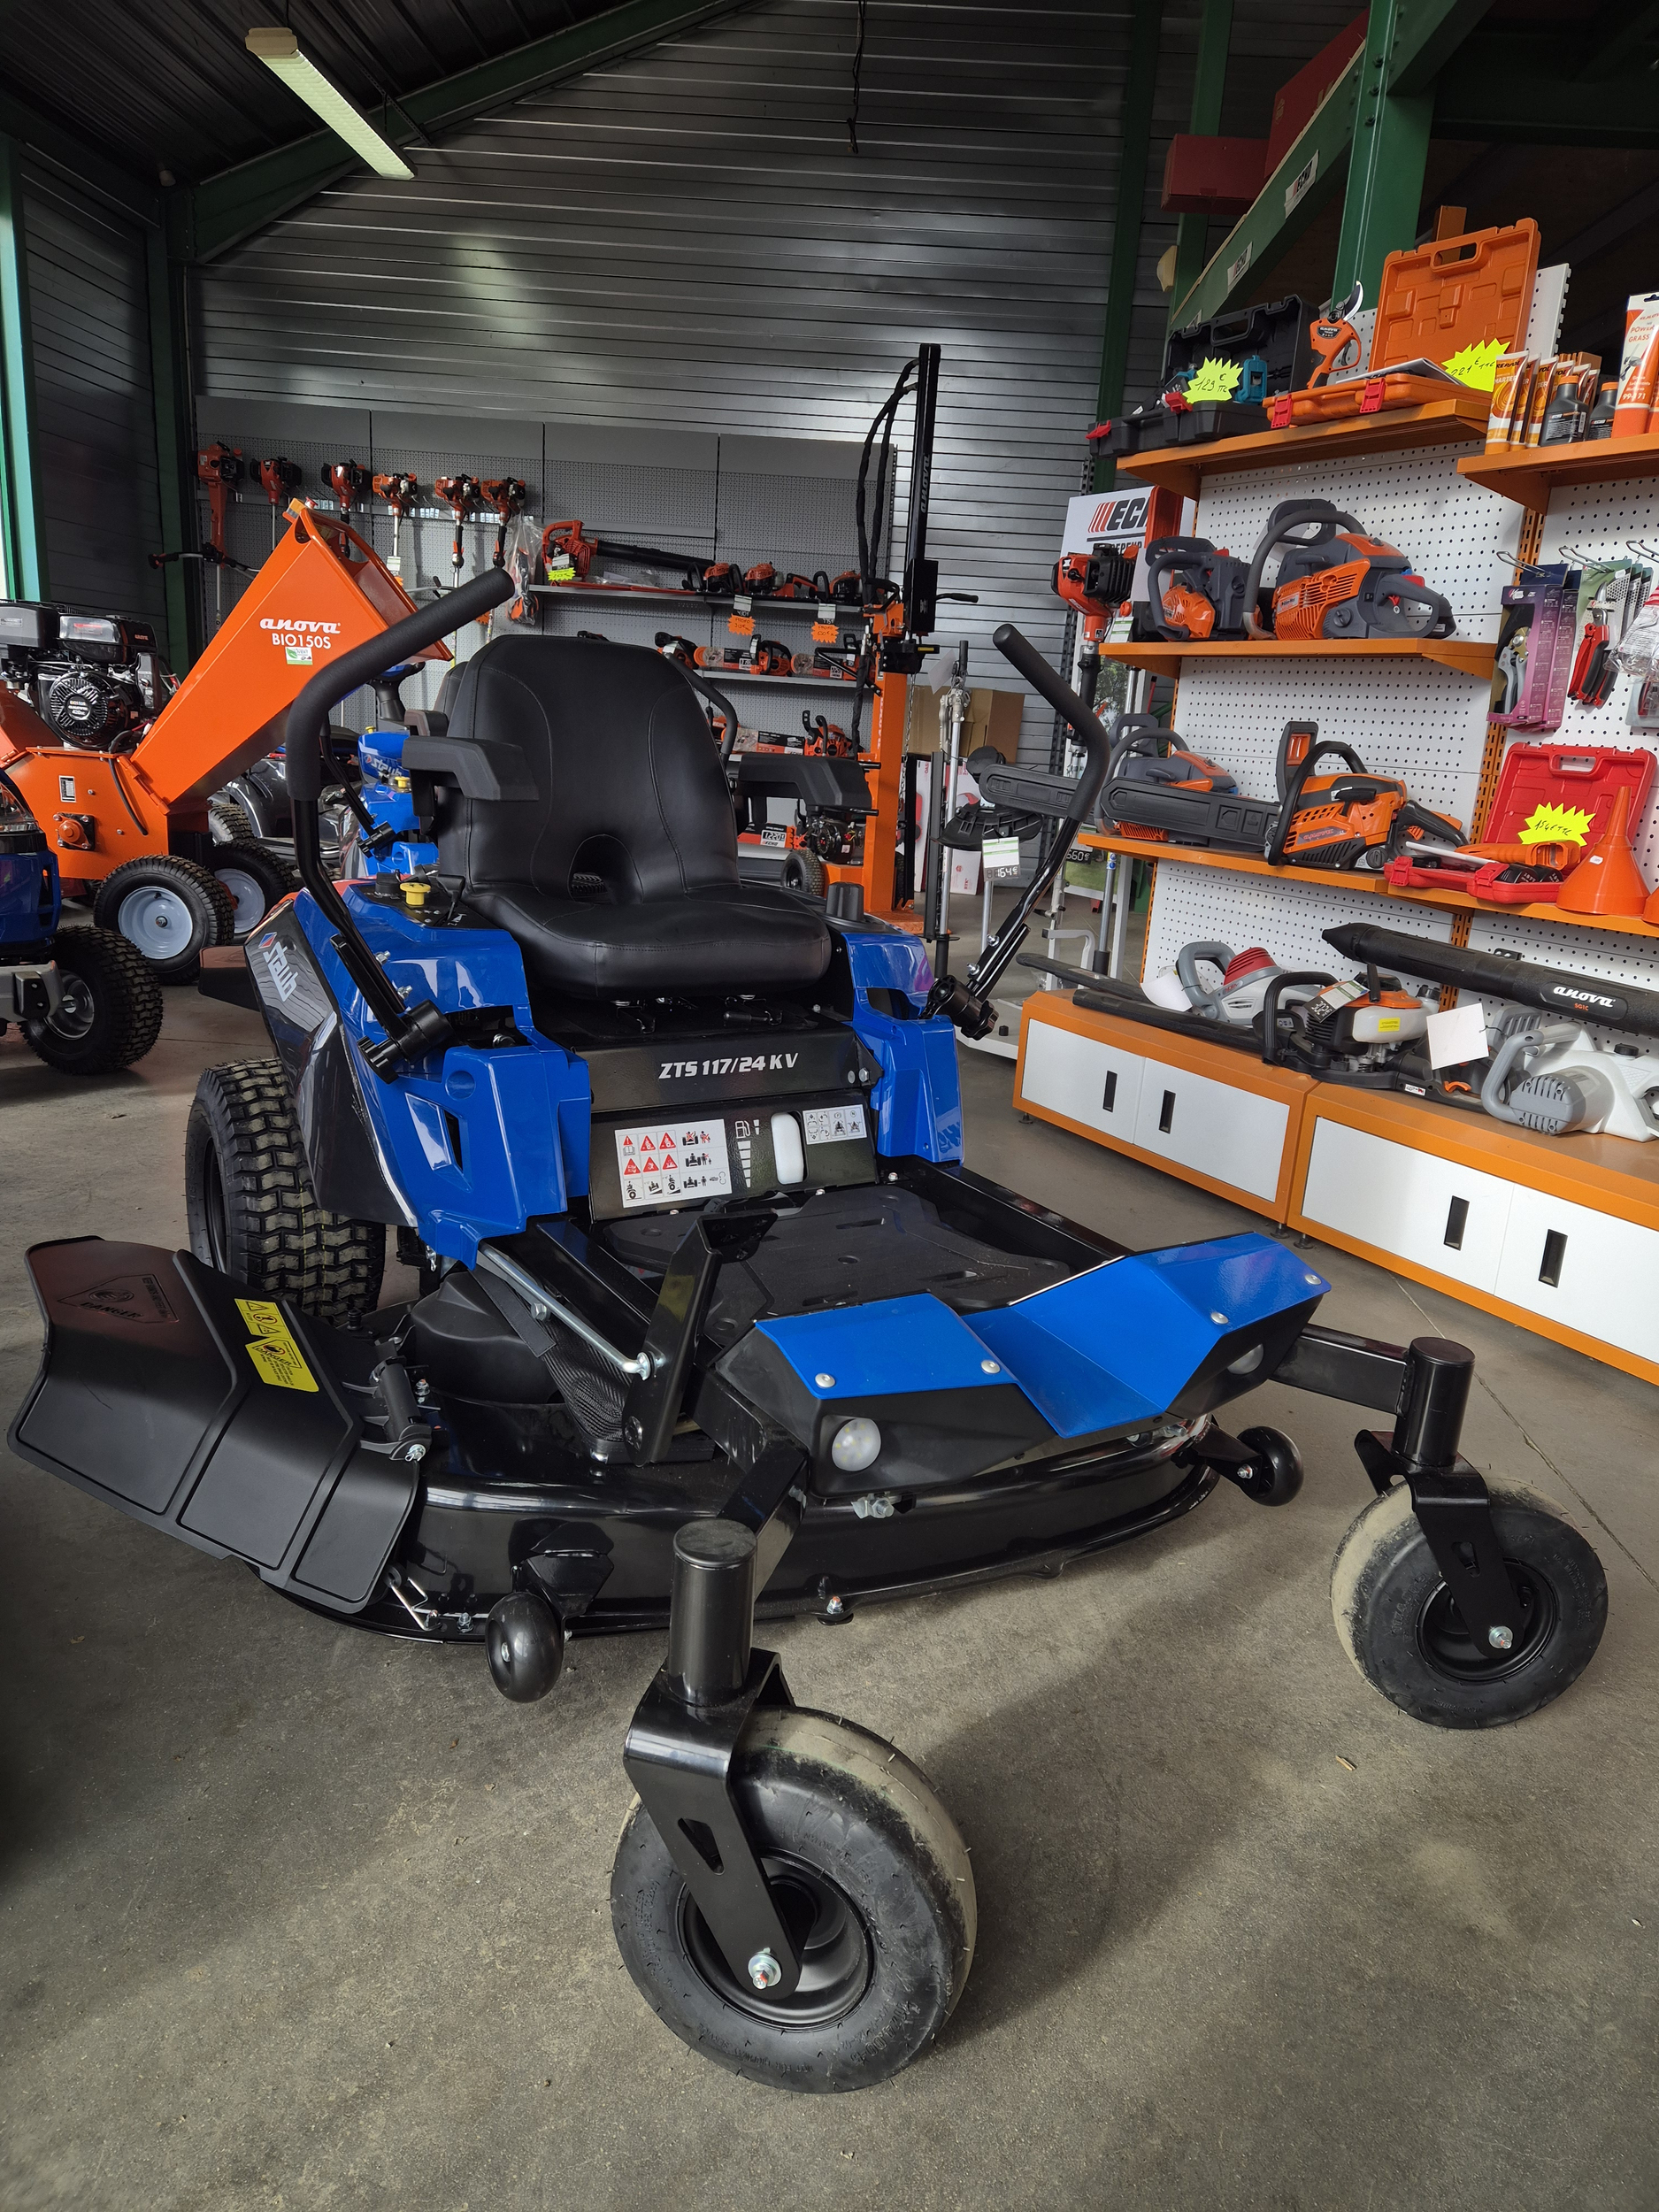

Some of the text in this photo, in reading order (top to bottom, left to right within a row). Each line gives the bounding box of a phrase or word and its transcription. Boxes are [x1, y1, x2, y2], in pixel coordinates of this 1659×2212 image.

[1628, 334, 1650, 342] GRASS
[272, 633, 332, 649] BIO150S
[263, 941, 299, 1002] staub
[658, 1061, 698, 1079] ZTS
[702, 1056, 766, 1076] 117/24
[256, 1346, 293, 1366] DANGER
